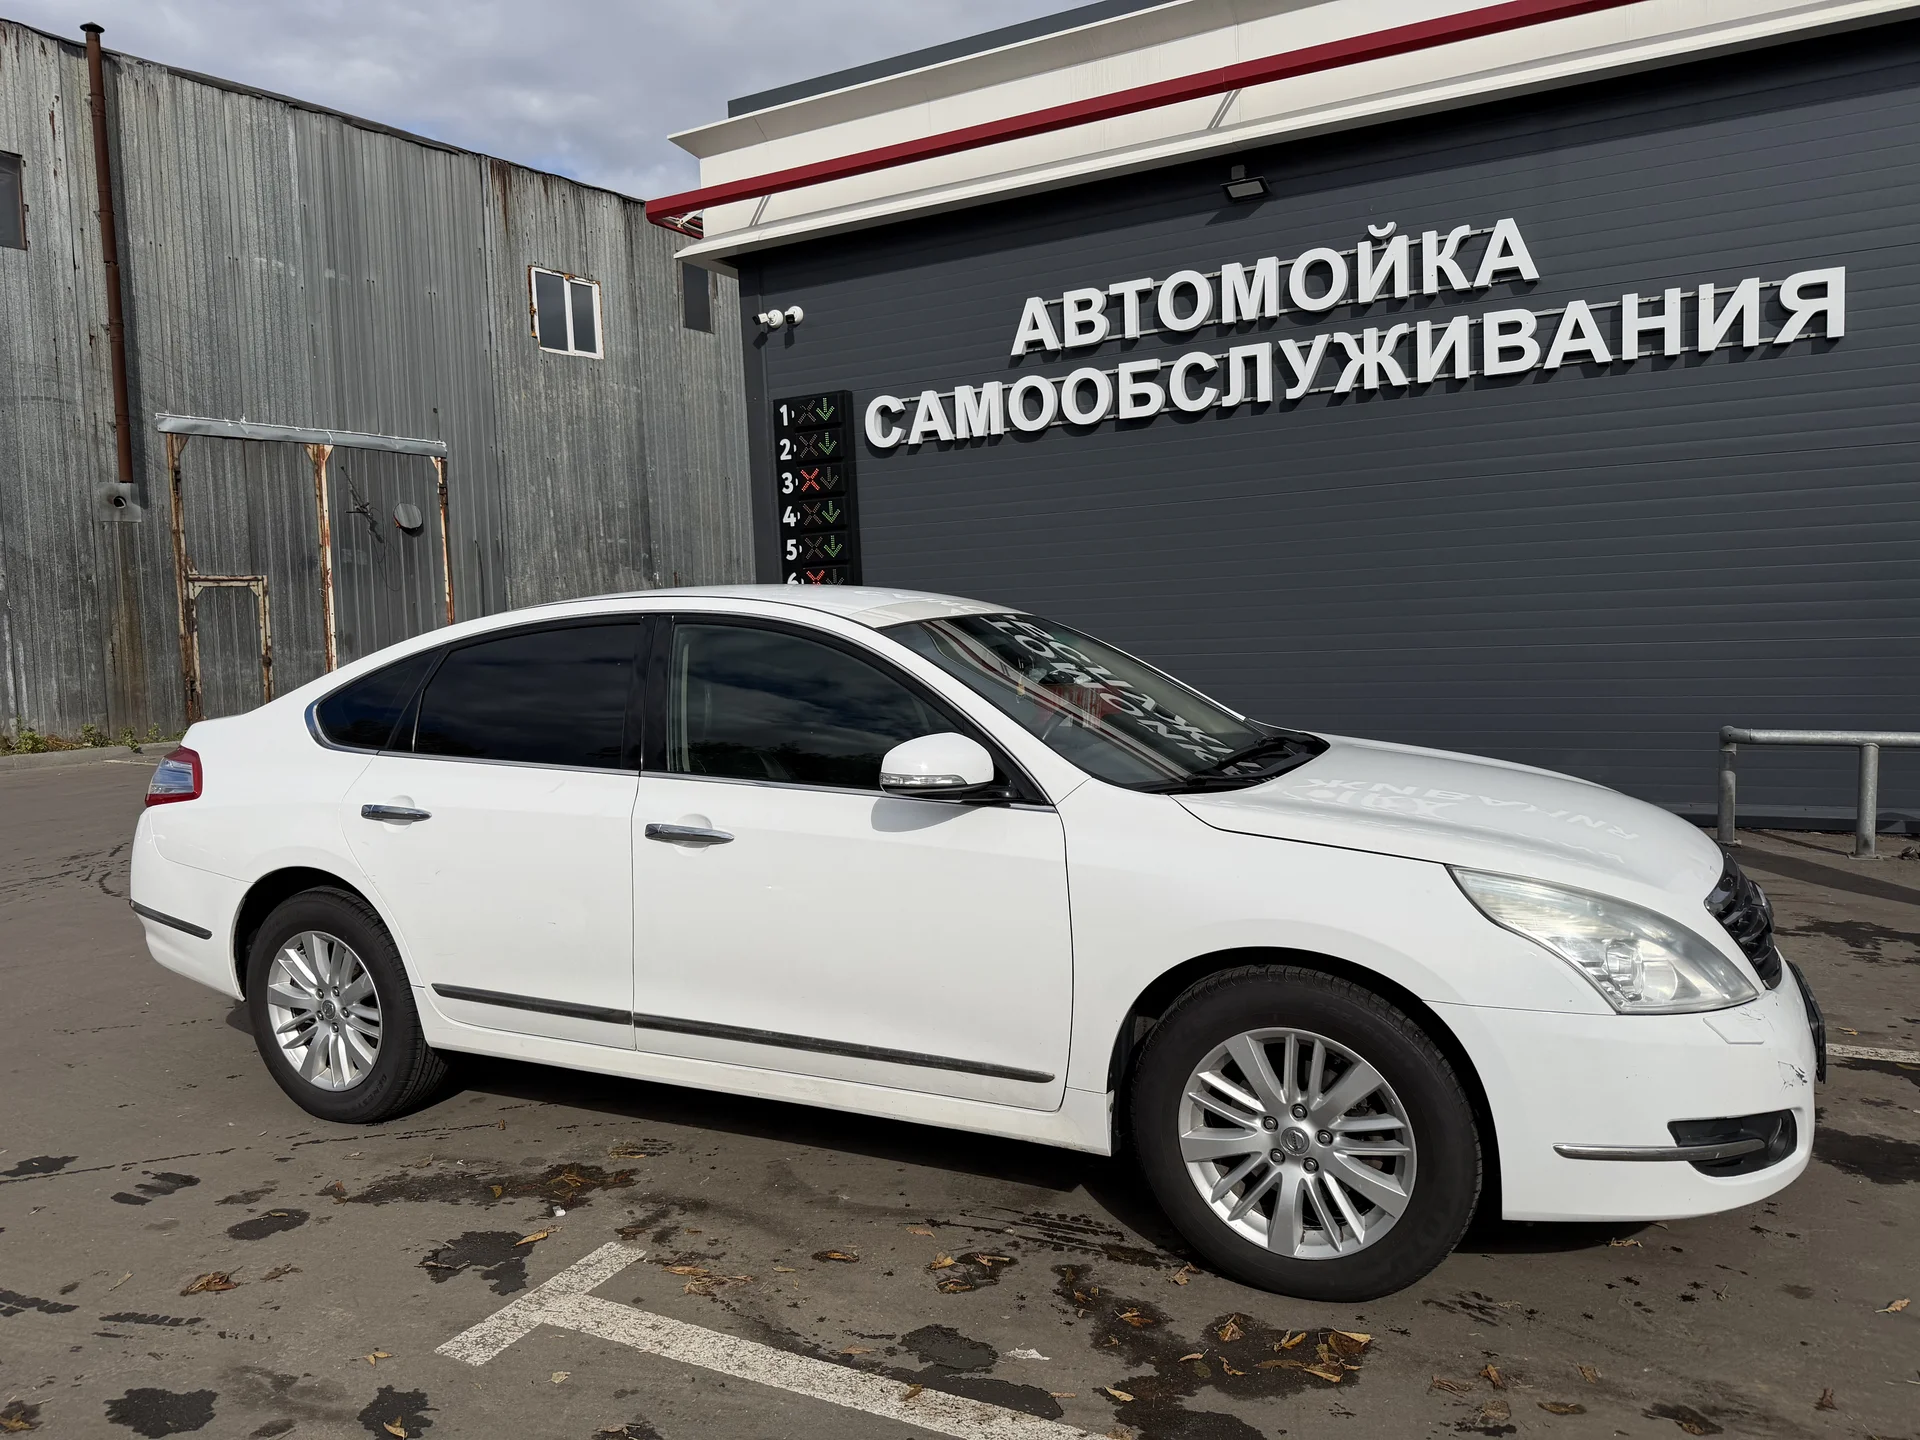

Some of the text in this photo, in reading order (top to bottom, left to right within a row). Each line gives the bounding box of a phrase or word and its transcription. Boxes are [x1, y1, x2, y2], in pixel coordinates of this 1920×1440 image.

[1011, 217, 1540, 356] АВТОМОЙКА
[865, 266, 1846, 448] САМООБСЛУЖИВАНИЯ
[779, 404, 789, 426] 1
[780, 438, 792, 461] 2
[781, 472, 794, 494] 3
[782, 505, 797, 527] 4
[786, 538, 798, 561] 5
